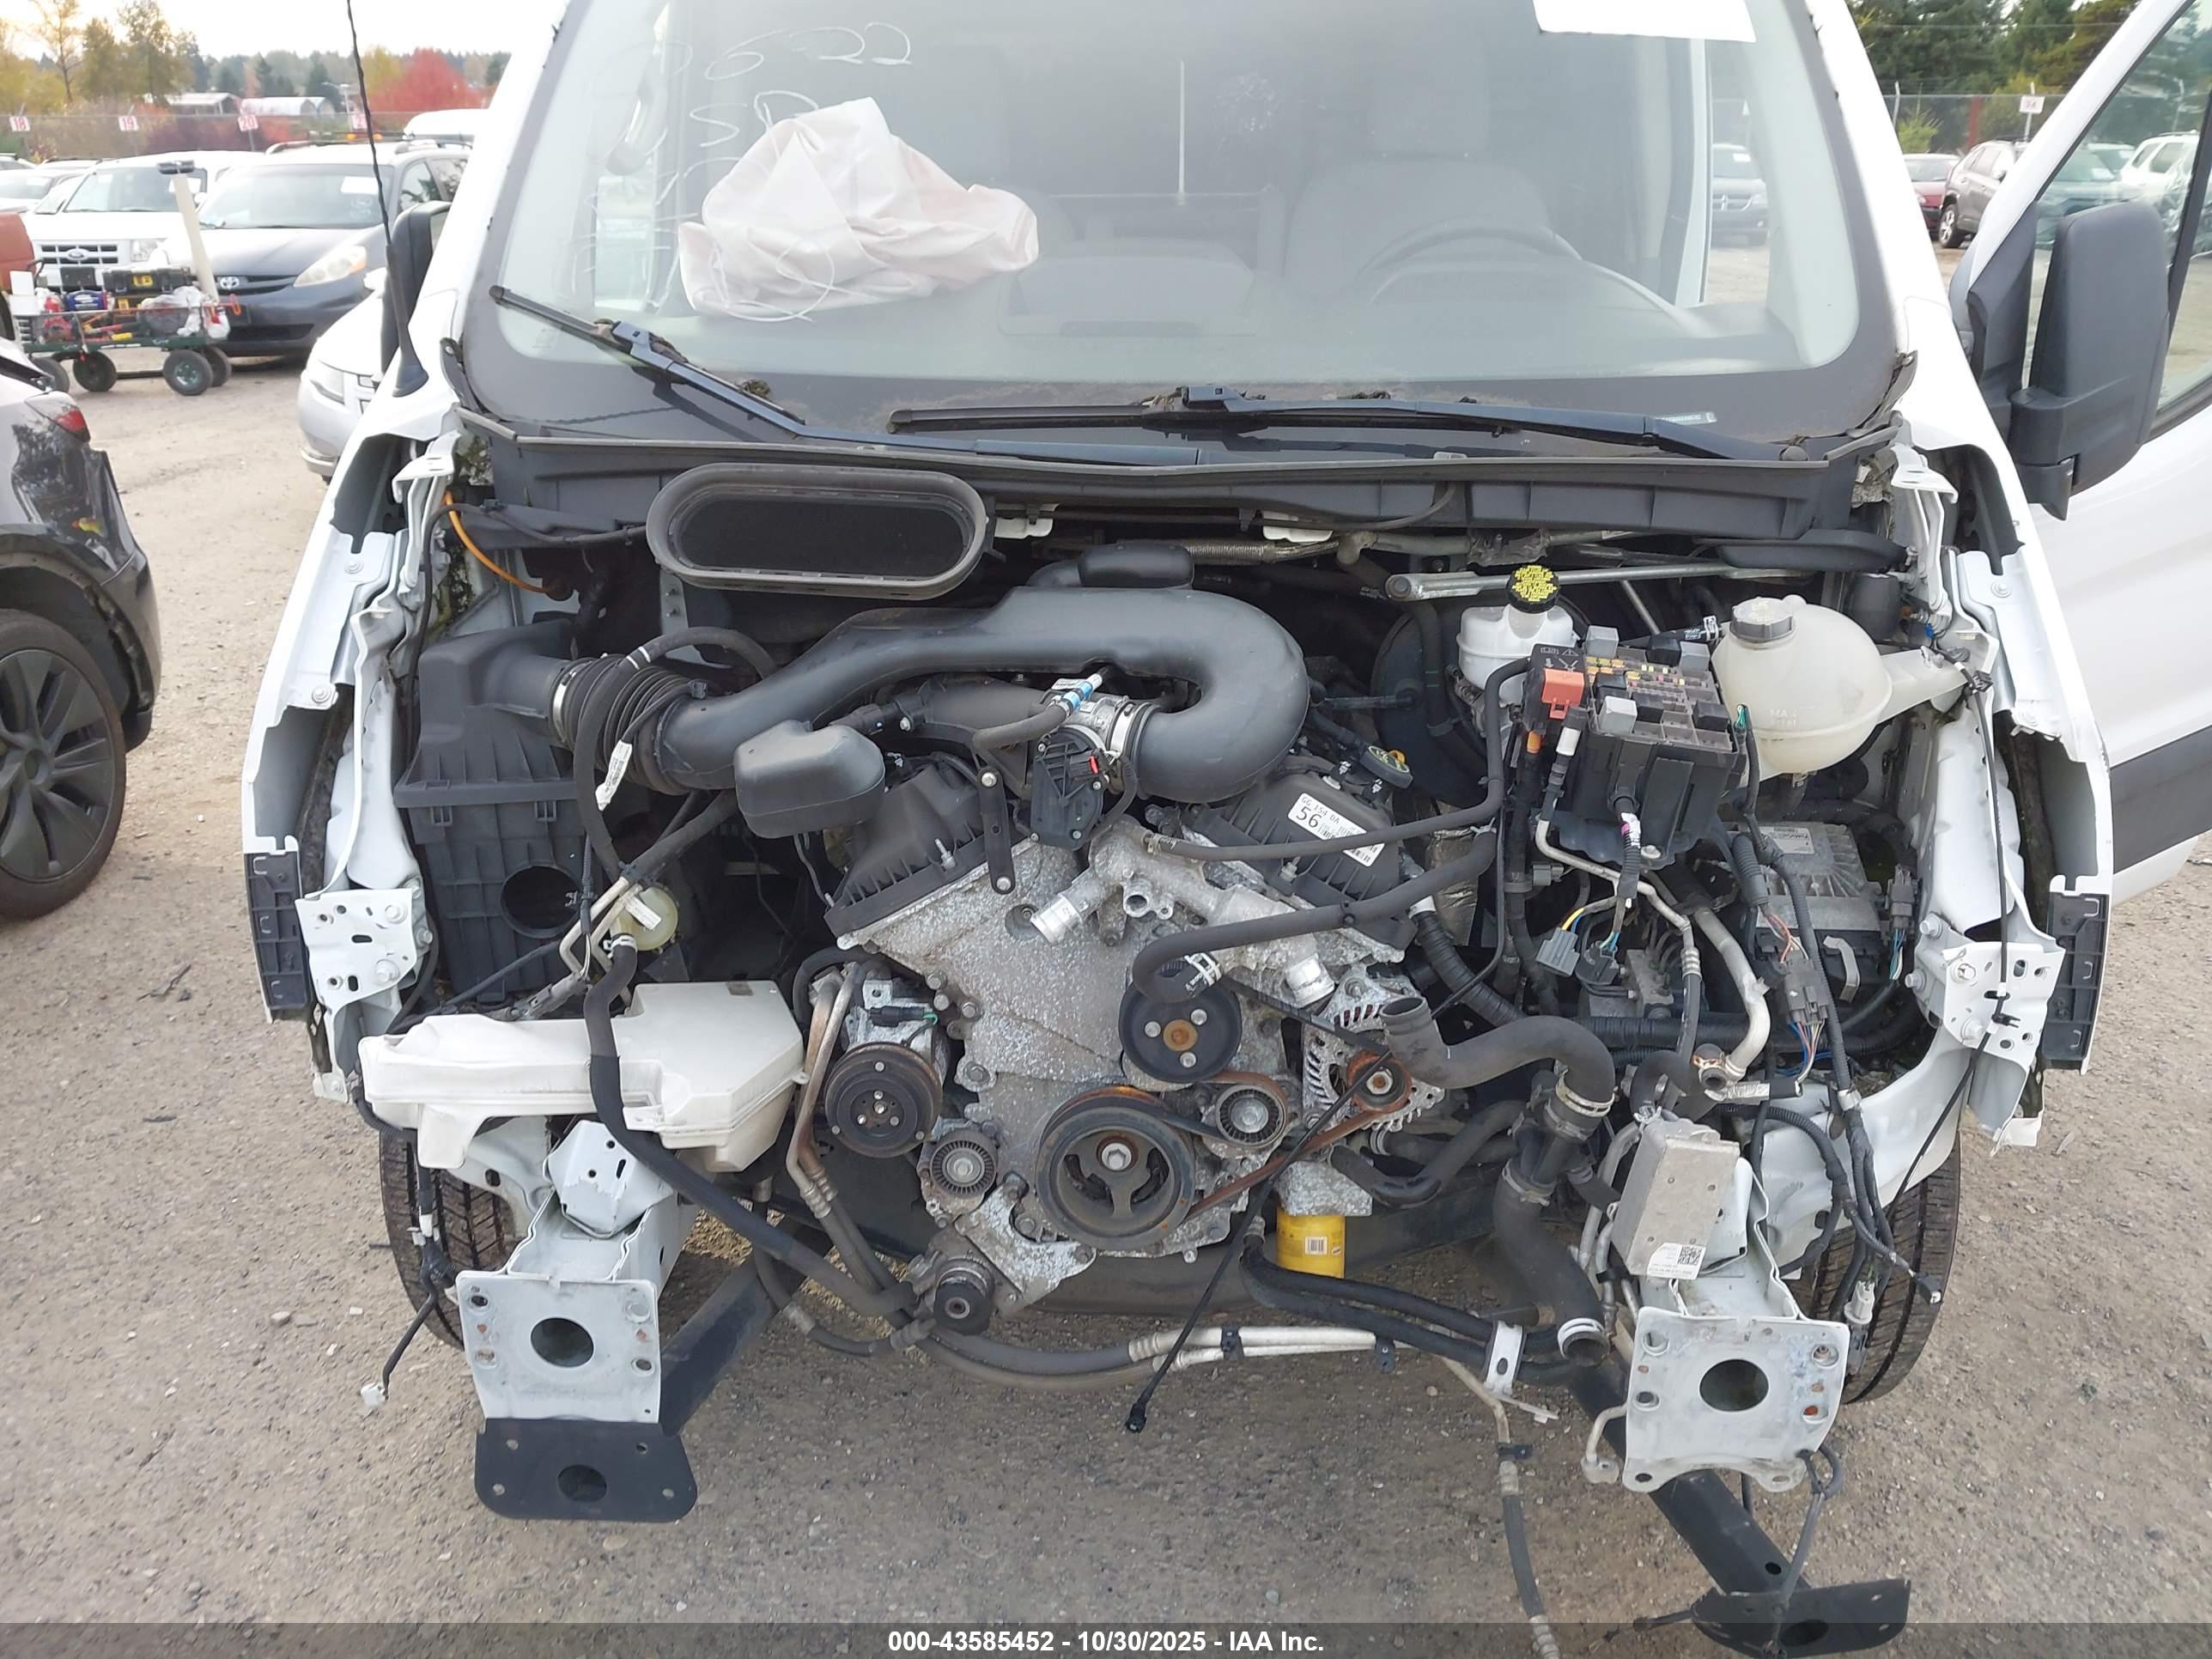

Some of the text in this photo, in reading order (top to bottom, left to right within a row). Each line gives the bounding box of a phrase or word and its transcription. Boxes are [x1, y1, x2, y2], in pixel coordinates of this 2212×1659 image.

[13, 117, 26, 130] 18
[123, 117, 135, 129] 19
[1295, 806, 1322, 829] 56
